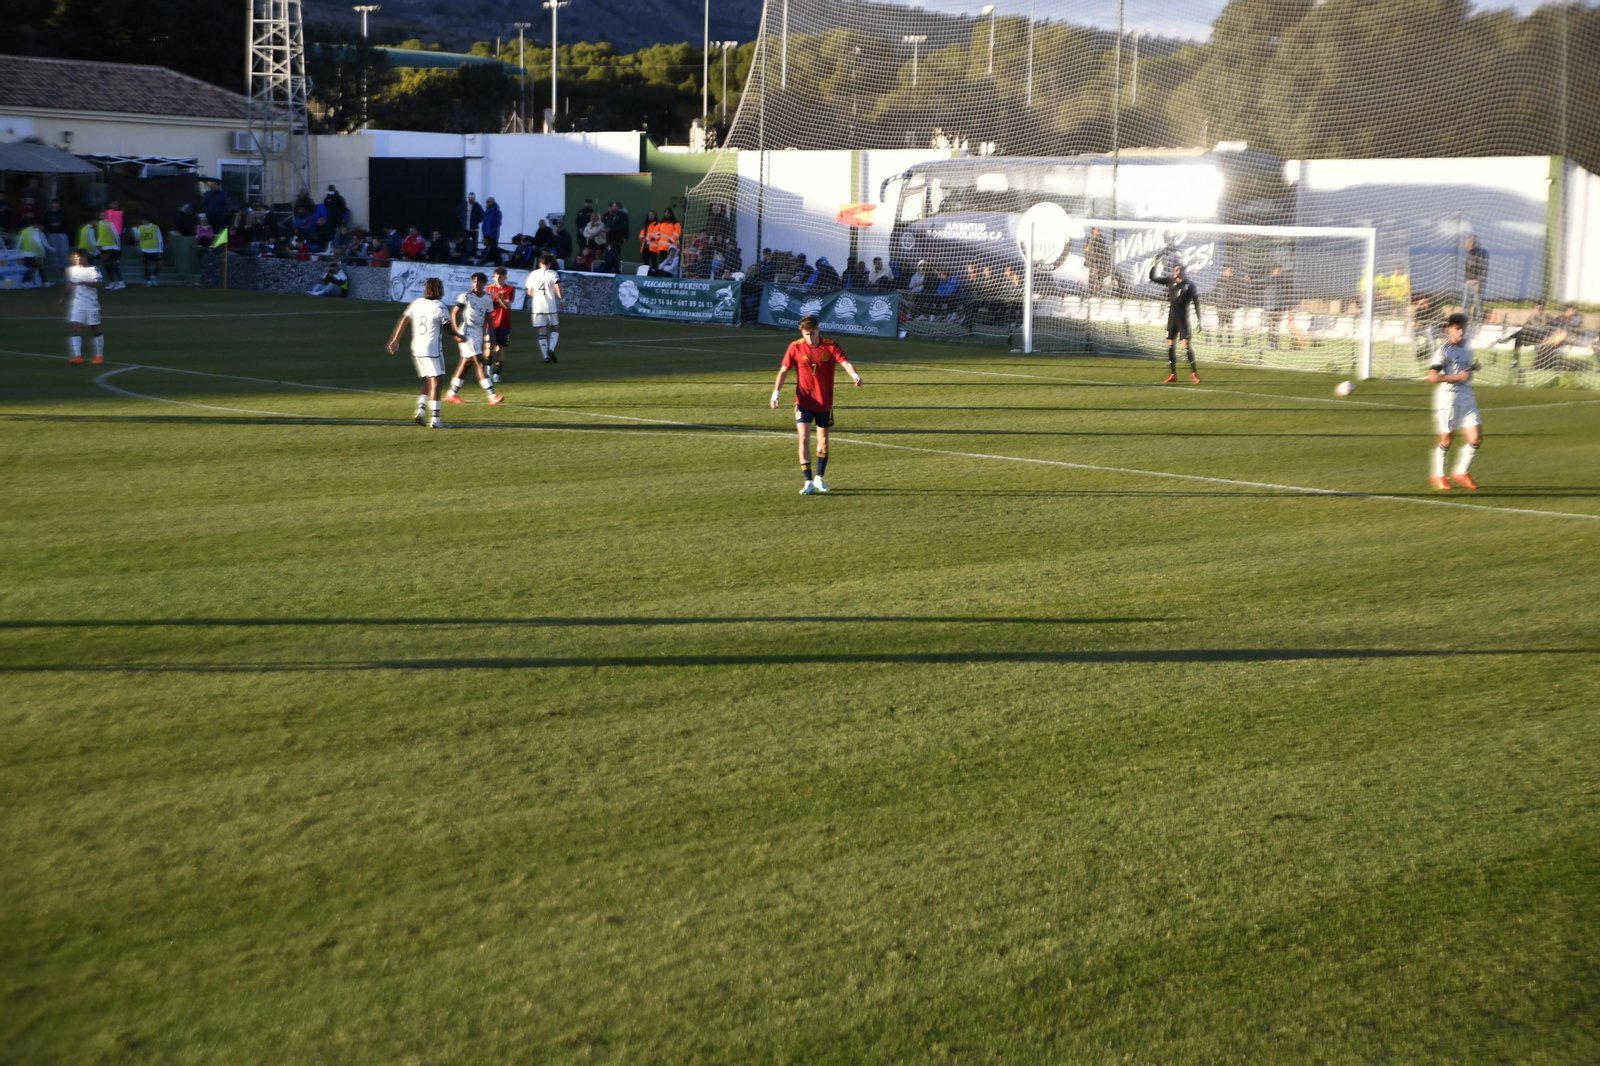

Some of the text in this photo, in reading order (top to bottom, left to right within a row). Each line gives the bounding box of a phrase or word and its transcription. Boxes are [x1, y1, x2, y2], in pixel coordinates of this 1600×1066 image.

[945, 222, 986, 232] JUVENTUD
[926, 230, 1005, 240] TORREMOLINOS C.F.
[538, 282, 546, 296] 4
[643, 280, 673, 289] PESCADOS
[679, 283, 710, 291] MARISCOS
[418, 315, 428, 335] 8
[811, 363, 817, 375] 7
